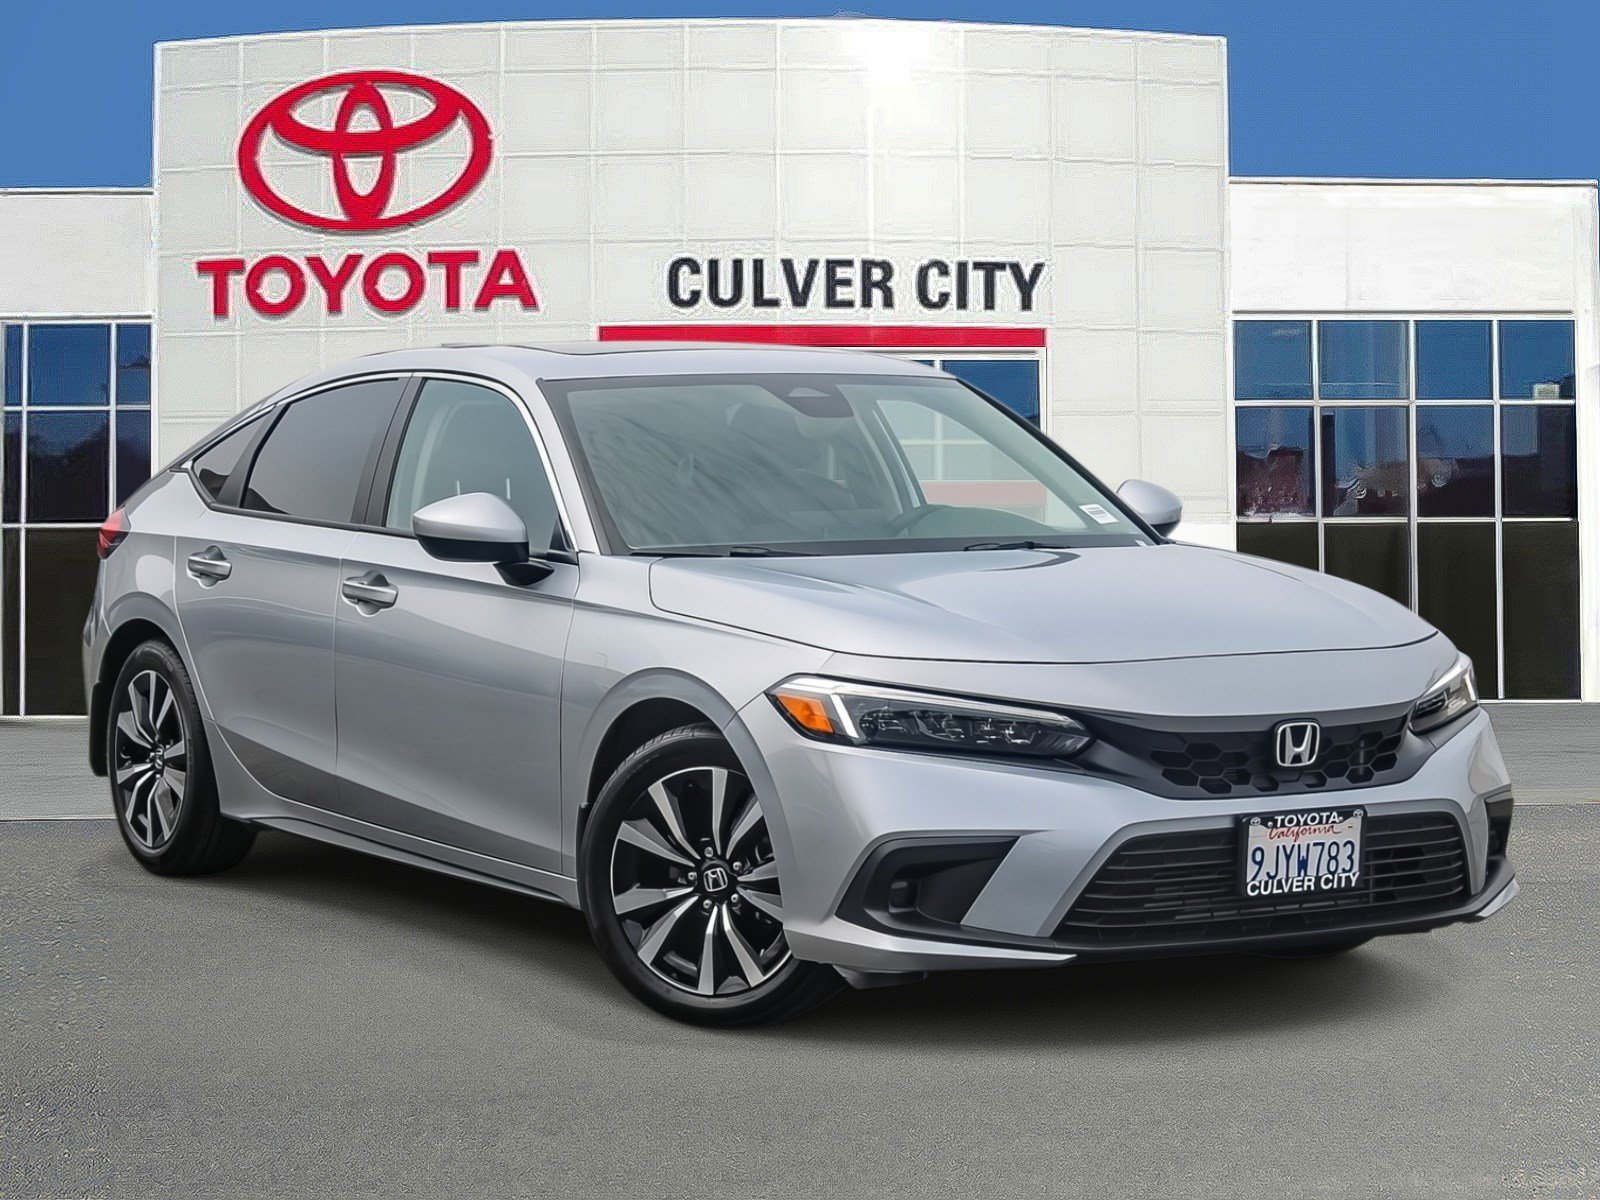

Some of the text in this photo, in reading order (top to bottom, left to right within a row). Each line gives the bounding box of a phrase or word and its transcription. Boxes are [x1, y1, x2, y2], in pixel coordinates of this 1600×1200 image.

[196, 249, 540, 318] TOYOTA
[667, 257, 1046, 311] CULVER CITY
[1268, 824, 1343, 842] California
[1274, 811, 1340, 828] TOYOTA
[1250, 840, 1356, 883] 9JYW783
[1246, 872, 1360, 896] CULVER CITY
